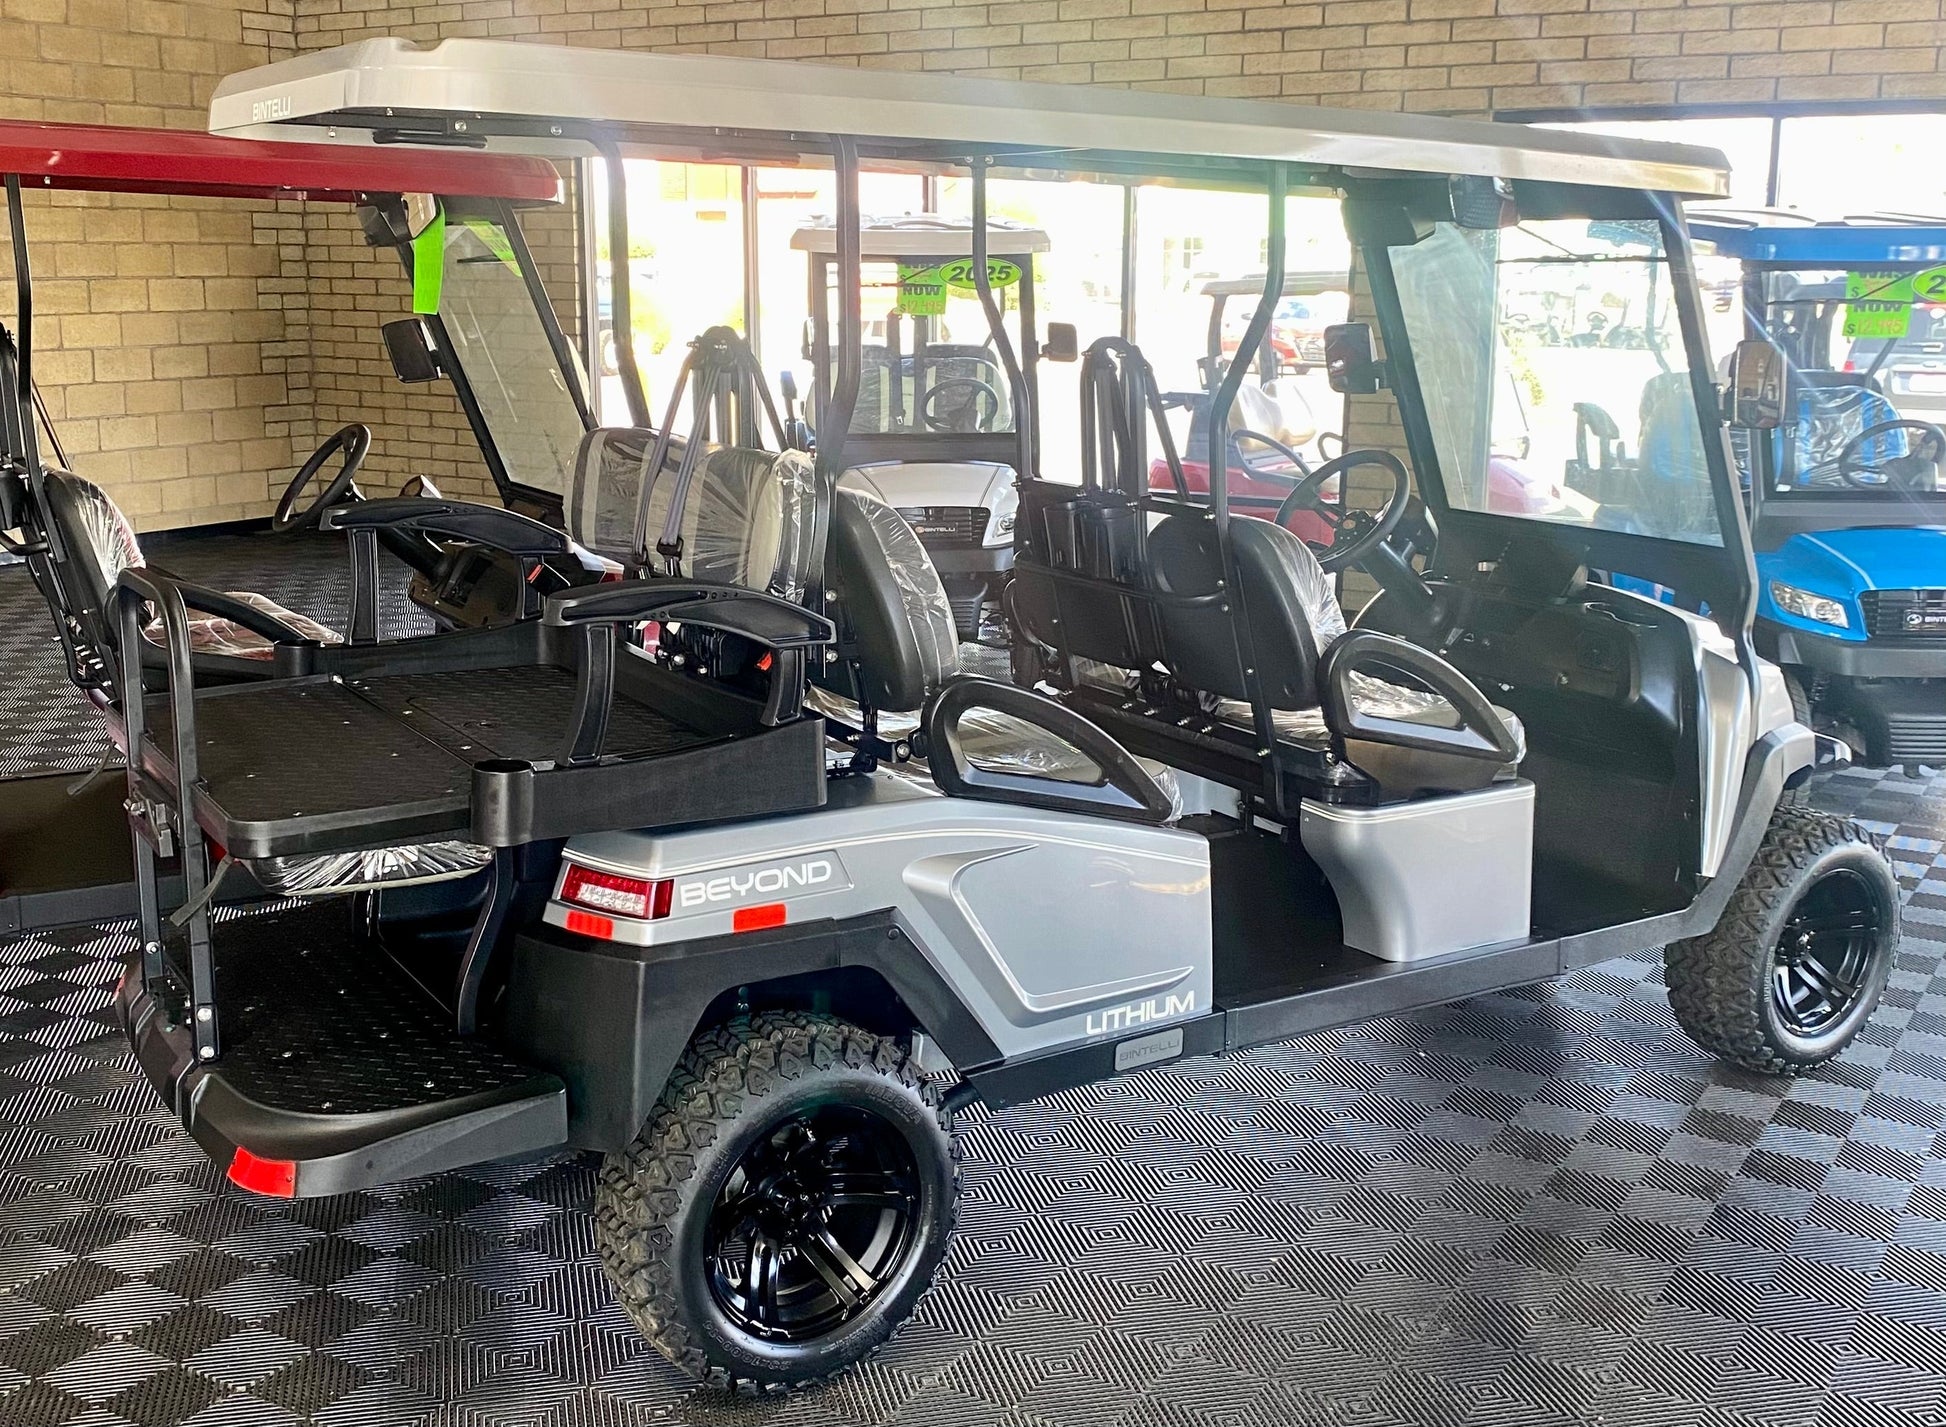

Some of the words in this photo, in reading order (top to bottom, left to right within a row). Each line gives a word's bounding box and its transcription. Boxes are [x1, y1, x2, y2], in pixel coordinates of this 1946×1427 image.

[252, 95, 291, 121] BINTELLI
[902, 284, 940, 296] NOW
[680, 860, 832, 907] BEYOND
[1086, 990, 1195, 1035] LITHIUM
[1119, 1040, 1180, 1062] BINTELLI
